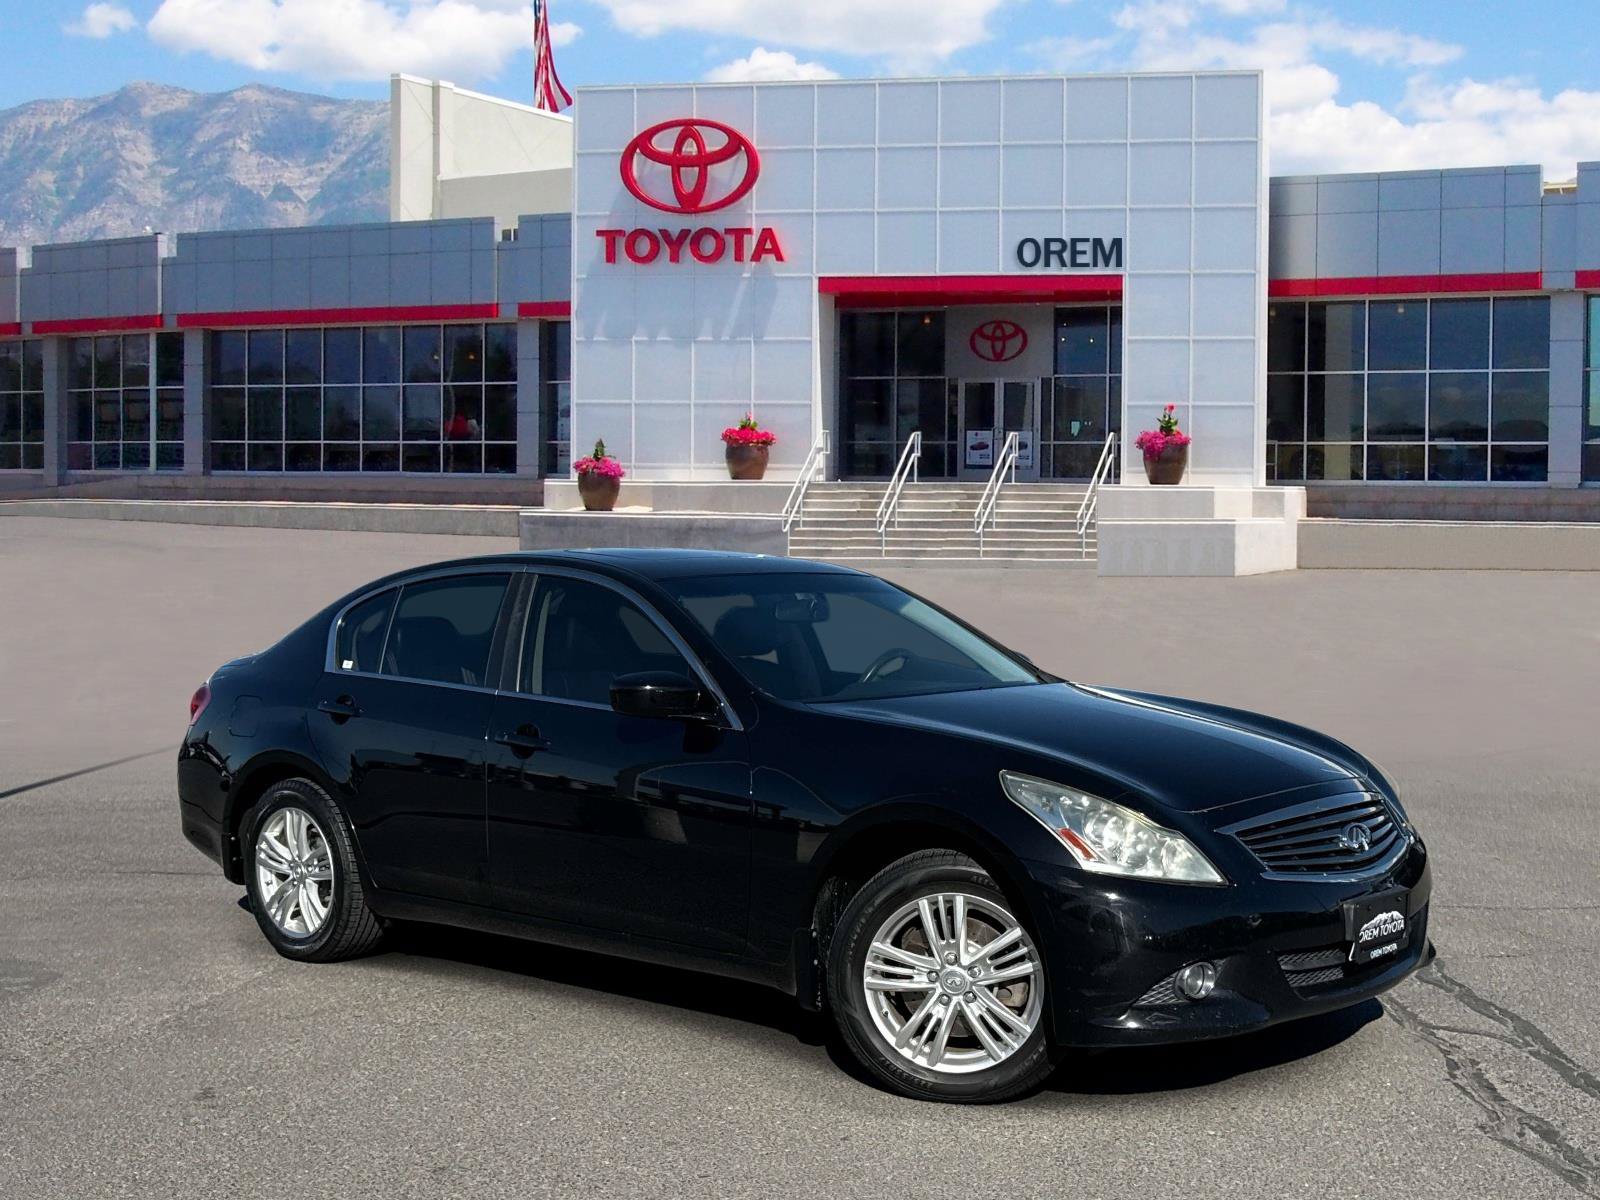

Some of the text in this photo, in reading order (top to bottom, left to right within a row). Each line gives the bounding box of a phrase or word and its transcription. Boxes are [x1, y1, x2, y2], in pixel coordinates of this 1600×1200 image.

[596, 227, 785, 265] TOYOTA
[1017, 237, 1123, 268] OREM
[1359, 919, 1404, 943] OREM TOYOTA
